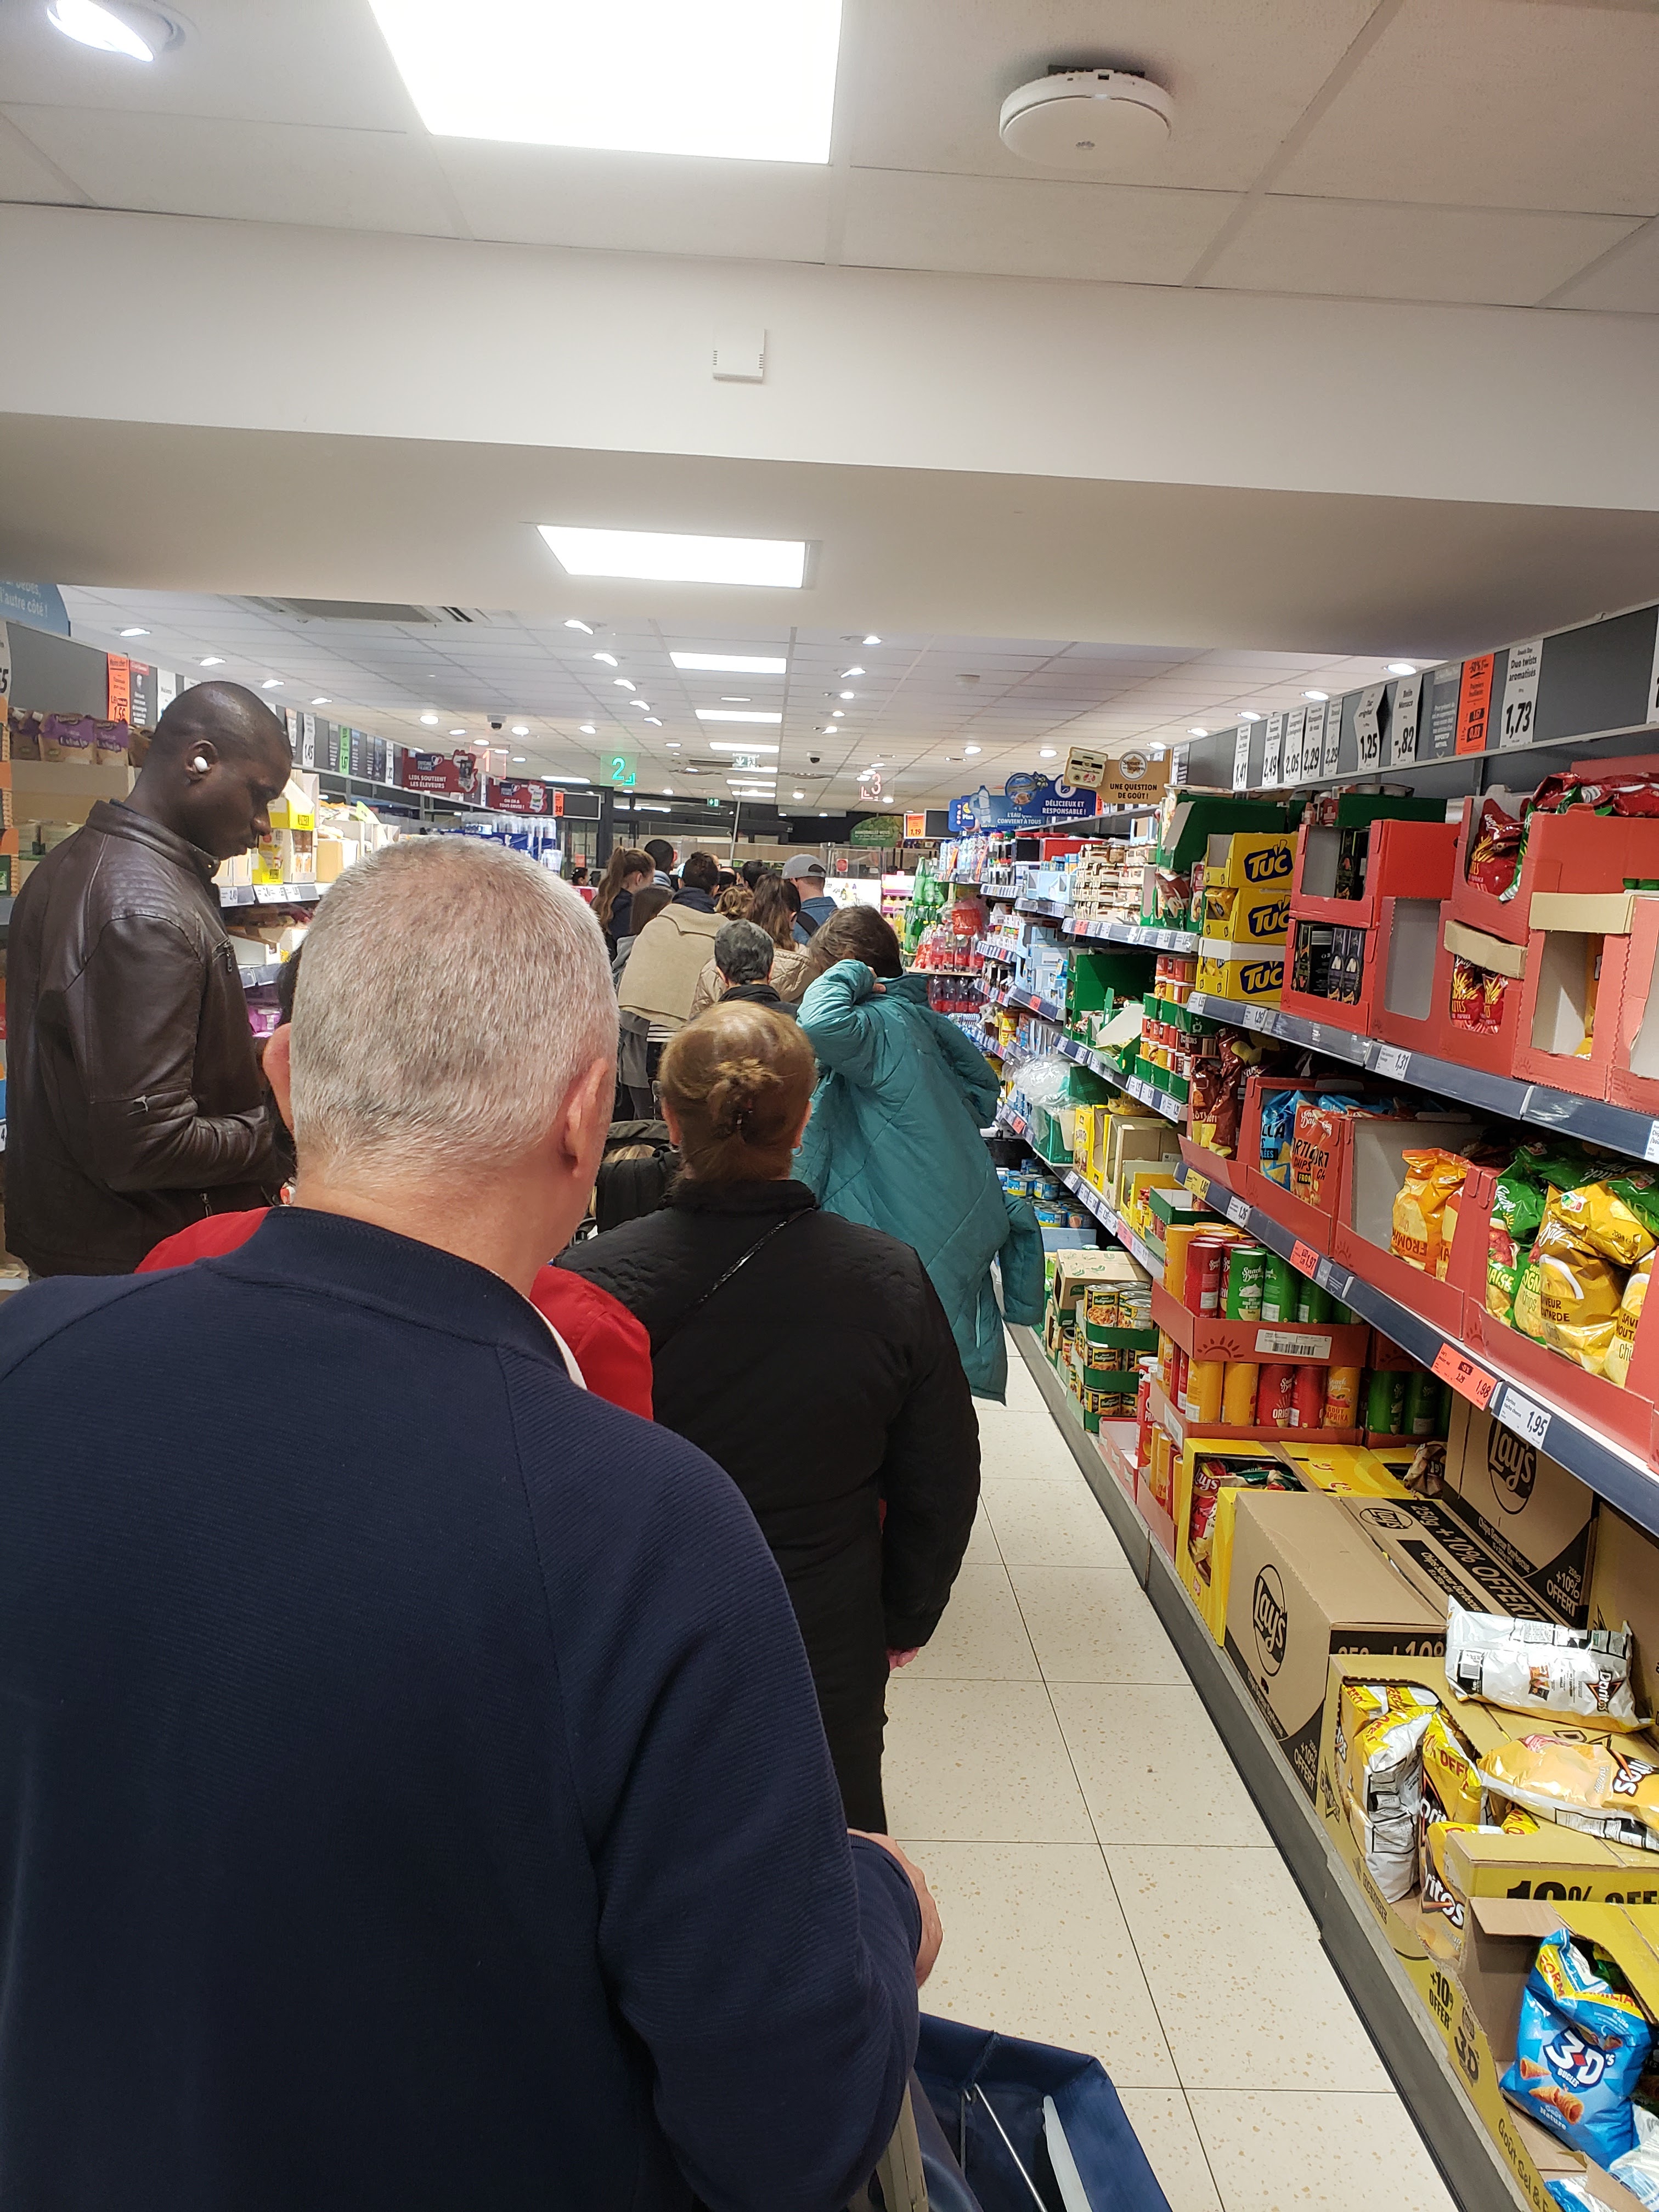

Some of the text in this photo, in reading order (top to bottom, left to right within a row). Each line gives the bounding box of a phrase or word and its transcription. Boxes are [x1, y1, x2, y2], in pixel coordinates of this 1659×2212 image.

[1511, 656, 1537, 669] Duo twists
[1509, 669, 1536, 681] aromatisés
[1506, 701, 1532, 739] 1,73
[1361, 733, 1378, 763] 1,25
[482, 749, 490, 772] 1
[612, 757, 625, 781] 2
[1264, 755, 1277, 780] 2,49
[1286, 753, 1300, 776] 2,05
[1304, 747, 1319, 774] 2,29
[871, 773, 881, 795] 3
[1236, 763, 1246, 786] 1,41
[1045, 799, 1076, 807] DÉLICIEUX
[1127, 791, 1145, 799] GOÛT
[1395, 1053, 1409, 1071] 1,31
[1305, 1254, 1316, 1269] 1,97
[1243, 1273, 1258, 1282] Day
[1476, 1379, 1491, 1398] 1,98
[1327, 1406, 1344, 1414] GOÛT
[1506, 1396, 1516, 1407] Doritos
[1526, 1410, 1548, 1436] 1,95
[1489, 1417, 1536, 1491] Lay's
[1410, 1505, 1441, 1527] 250g
[1507, 1543, 1531, 1573] Barbecue
[1555, 1570, 1580, 1600] +10%
[1546, 1579, 1579, 1617] OFFERT
[1254, 1579, 1286, 1652] Lay's
[1598, 1670, 1612, 1713] Doritos
[1294, 1748, 1316, 1791] OFFERT
[1558, 2069, 1579, 2088] BUGLES
[1539, 2106, 1567, 2130] Nature
[1498, 2118, 1517, 2165] Goût
[1517, 2159, 1531, 2194] Sel
